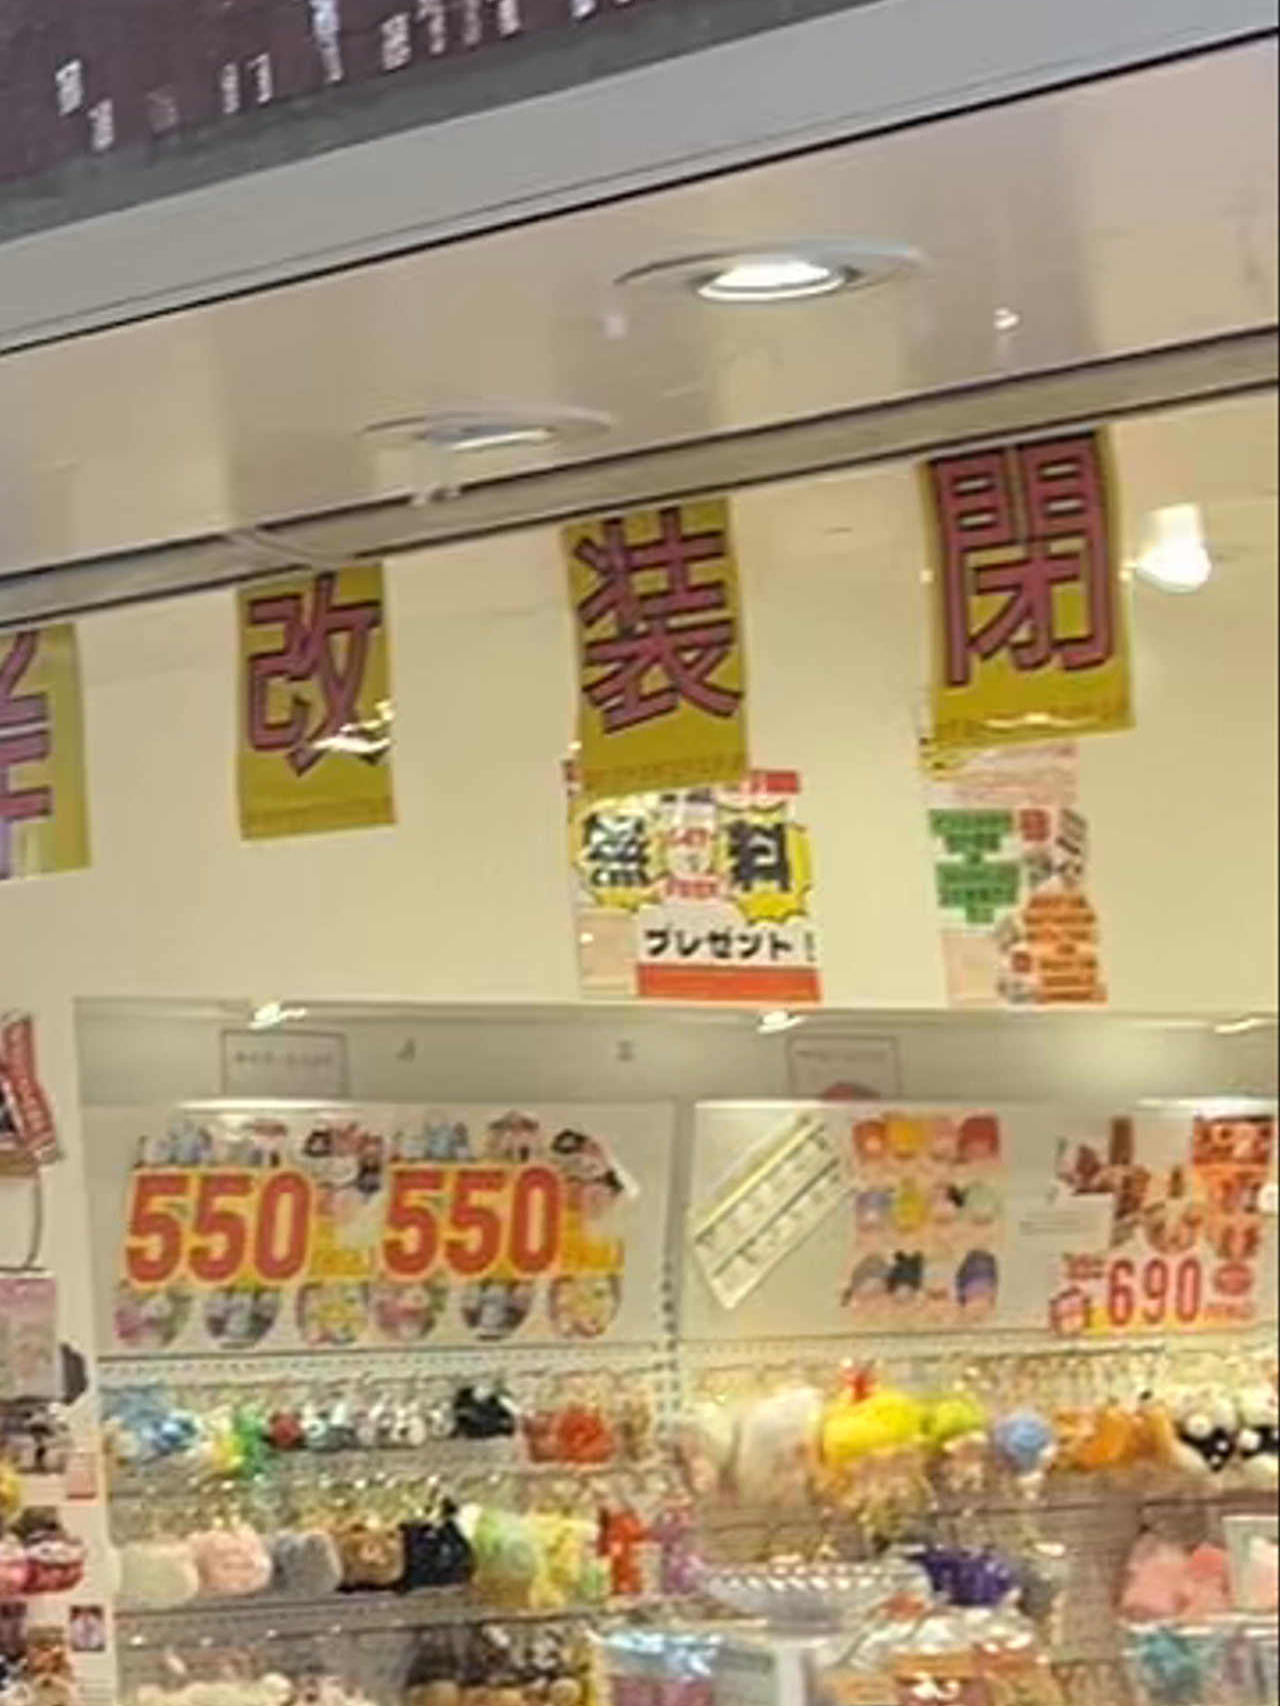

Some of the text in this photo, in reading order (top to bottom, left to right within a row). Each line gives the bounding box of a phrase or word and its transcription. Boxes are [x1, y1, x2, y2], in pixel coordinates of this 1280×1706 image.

[246, 571, 388, 776] 改
[573, 506, 744, 734] 装
[928, 430, 1113, 687] 閉
[126, 1165, 562, 1284] 550 550
[1107, 1257, 1201, 1327] 690
